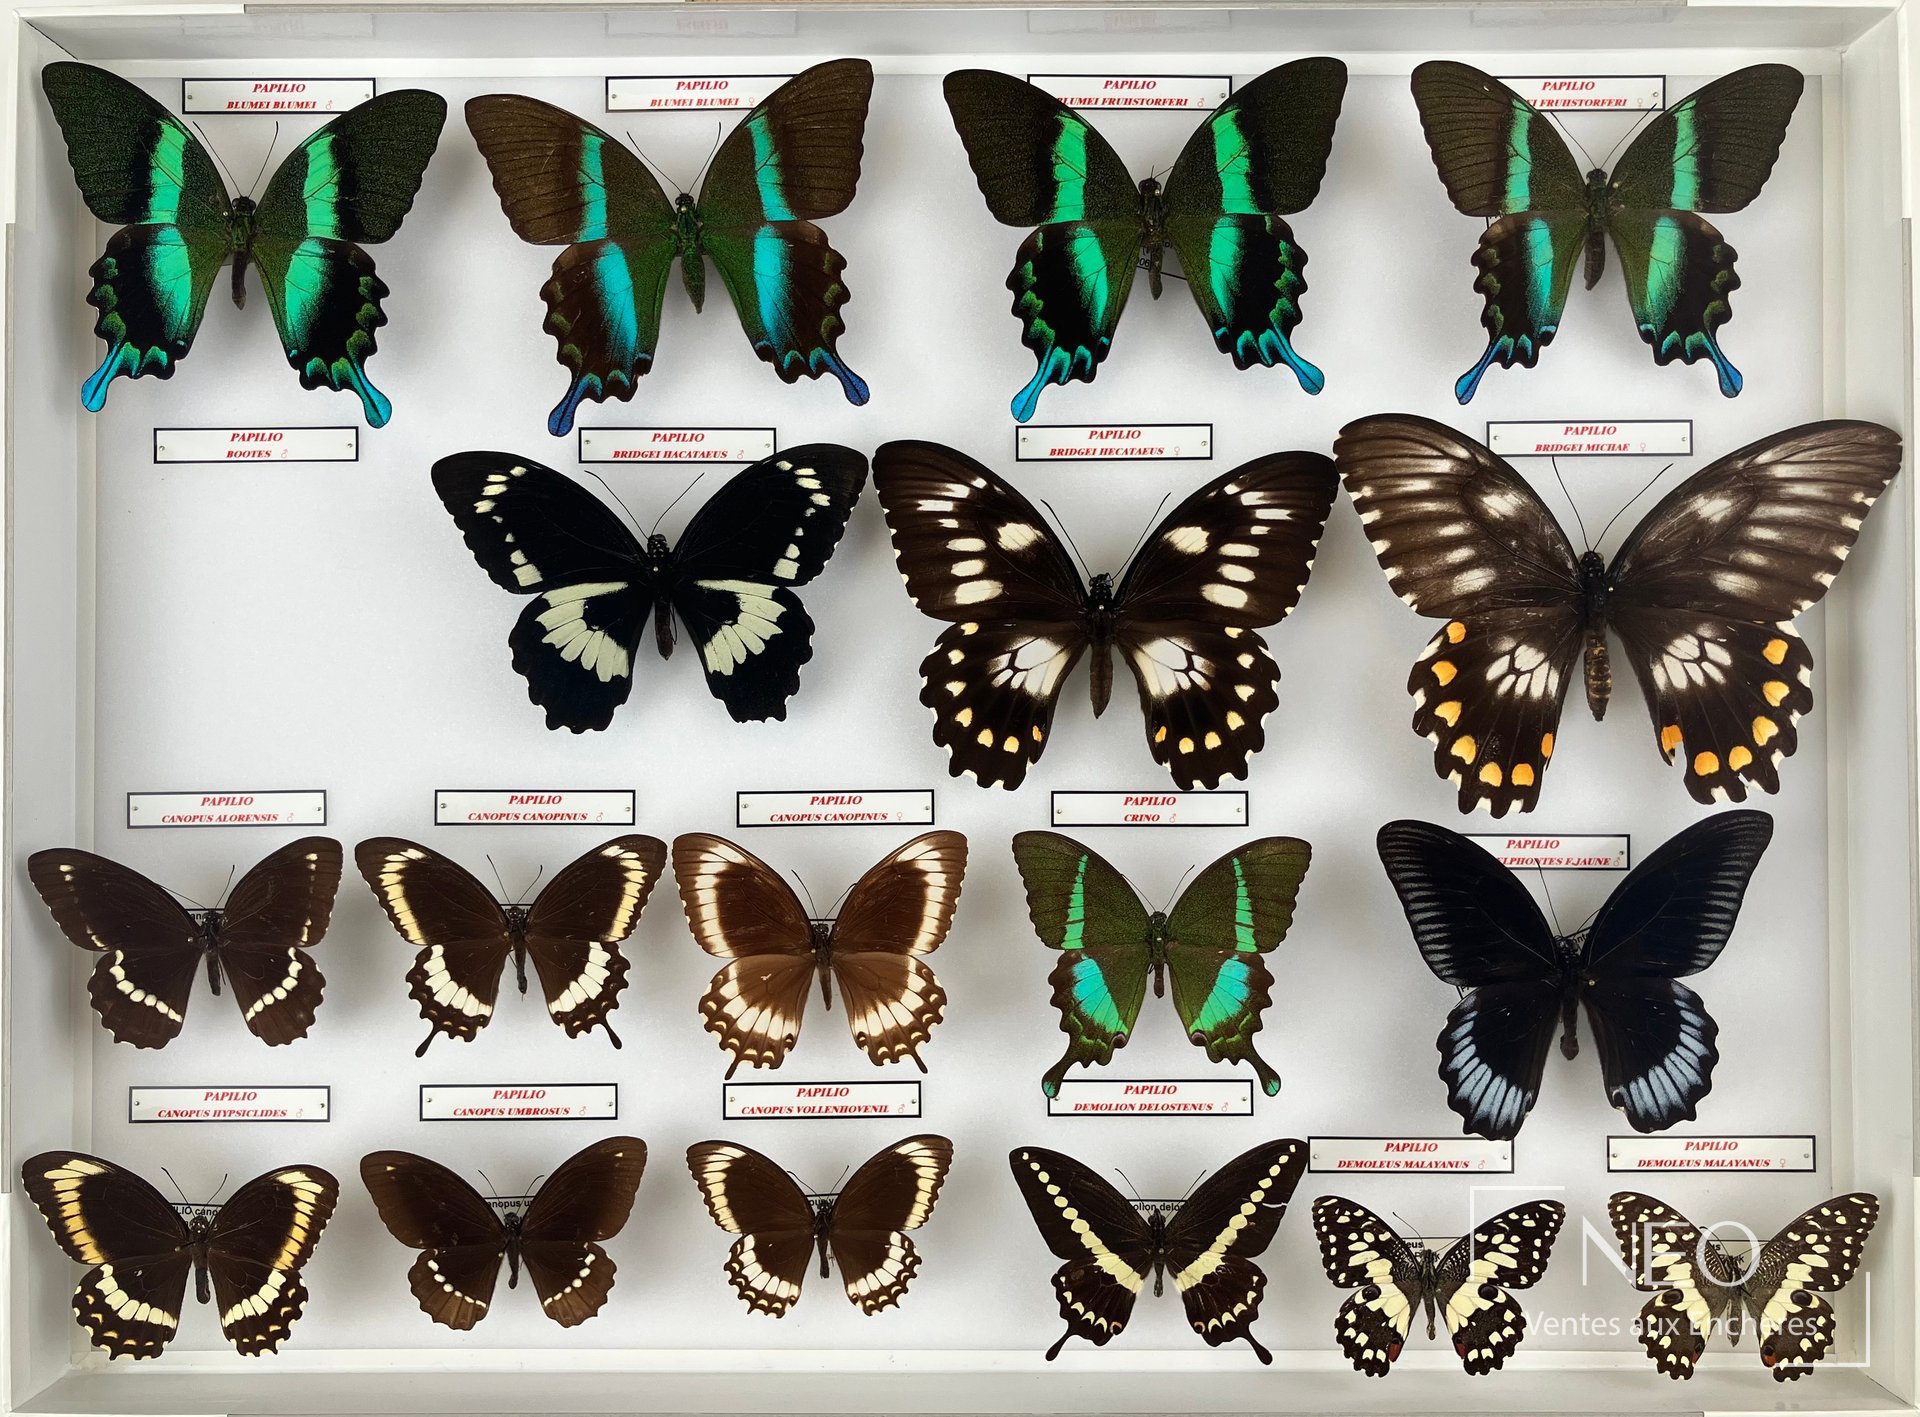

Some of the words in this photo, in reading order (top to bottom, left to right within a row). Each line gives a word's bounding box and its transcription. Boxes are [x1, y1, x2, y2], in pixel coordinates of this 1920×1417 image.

[252, 83, 306, 94] PAPILIO
[676, 80, 729, 91] PAPILIO
[1103, 79, 1157, 90] PAPILIO
[1541, 80, 1596, 92] PAPILIO
[227, 100, 271, 110] BLUMEI
[272, 100, 317, 110] BLUMEI
[649, 98, 693, 108] BLUMEI
[695, 97, 740, 107] BLUMEI
[1101, 97, 1189, 107] FRUHSTORFERI
[1539, 98, 1628, 108] FRUHSTORFERI
[1088, 429, 1142, 440] PAPILIO
[1563, 425, 1617, 436] PAPILIO
[230, 432, 284, 443] PAPILIO
[651, 432, 705, 443] PAPILIO
[1049, 447, 1097, 457] BRIDGEI
[1099, 447, 1164, 457] HECATAEUS
[1535, 443, 1583, 453] BRIDGEI
[1585, 442, 1630, 452] MICHAE
[226, 449, 272, 459] BOOTES
[612, 450, 661, 460] BRIDGEI
[662, 449, 728, 460] HACATAEUS
[201, 796, 255, 807] PAPILIO
[507, 794, 563, 805] PAPILIO
[809, 795, 864, 806] PAPILIO
[1123, 795, 1178, 807] PAPILIO
[161, 813, 214, 823] CANOPUS
[216, 813, 279, 823] ALORENSIS
[467, 812, 519, 822] CANOPUS
[521, 812, 588, 822] CANOPINUS
[769, 813, 822, 823] CANOPUS
[823, 812, 888, 822] CANOPINUS
[1123, 813, 1161, 823] CRINO
[1506, 838, 1561, 850] PAPILIO
[492, 1089, 547, 1100] PAPILIO
[796, 1087, 851, 1098] PAPILIO
[1123, 1084, 1178, 1096] PAPILIO
[204, 1091, 258, 1102] PAPILIO
[452, 1107, 506, 1117] CANOPUS
[507, 1106, 570, 1117] UMBROSUS
[740, 1105, 794, 1115] CANOPUS
[1073, 1102, 1137, 1112] DEMOLION
[1138, 1102, 1213, 1112] DELOSTENUS
[157, 1109, 210, 1119] CANOPUS
[212, 1109, 287, 1119] HYPSICLIDES
[1384, 1141, 1439, 1153] PAPILIO
[1684, 1140, 1739, 1152] PAPILIO
[1337, 1159, 1402, 1169] DEMOLEUS
[1403, 1159, 1471, 1169] MALAYANUS
[1637, 1158, 1702, 1168] DEMOLEUS
[1703, 1158, 1772, 1168] MALAYANUS
